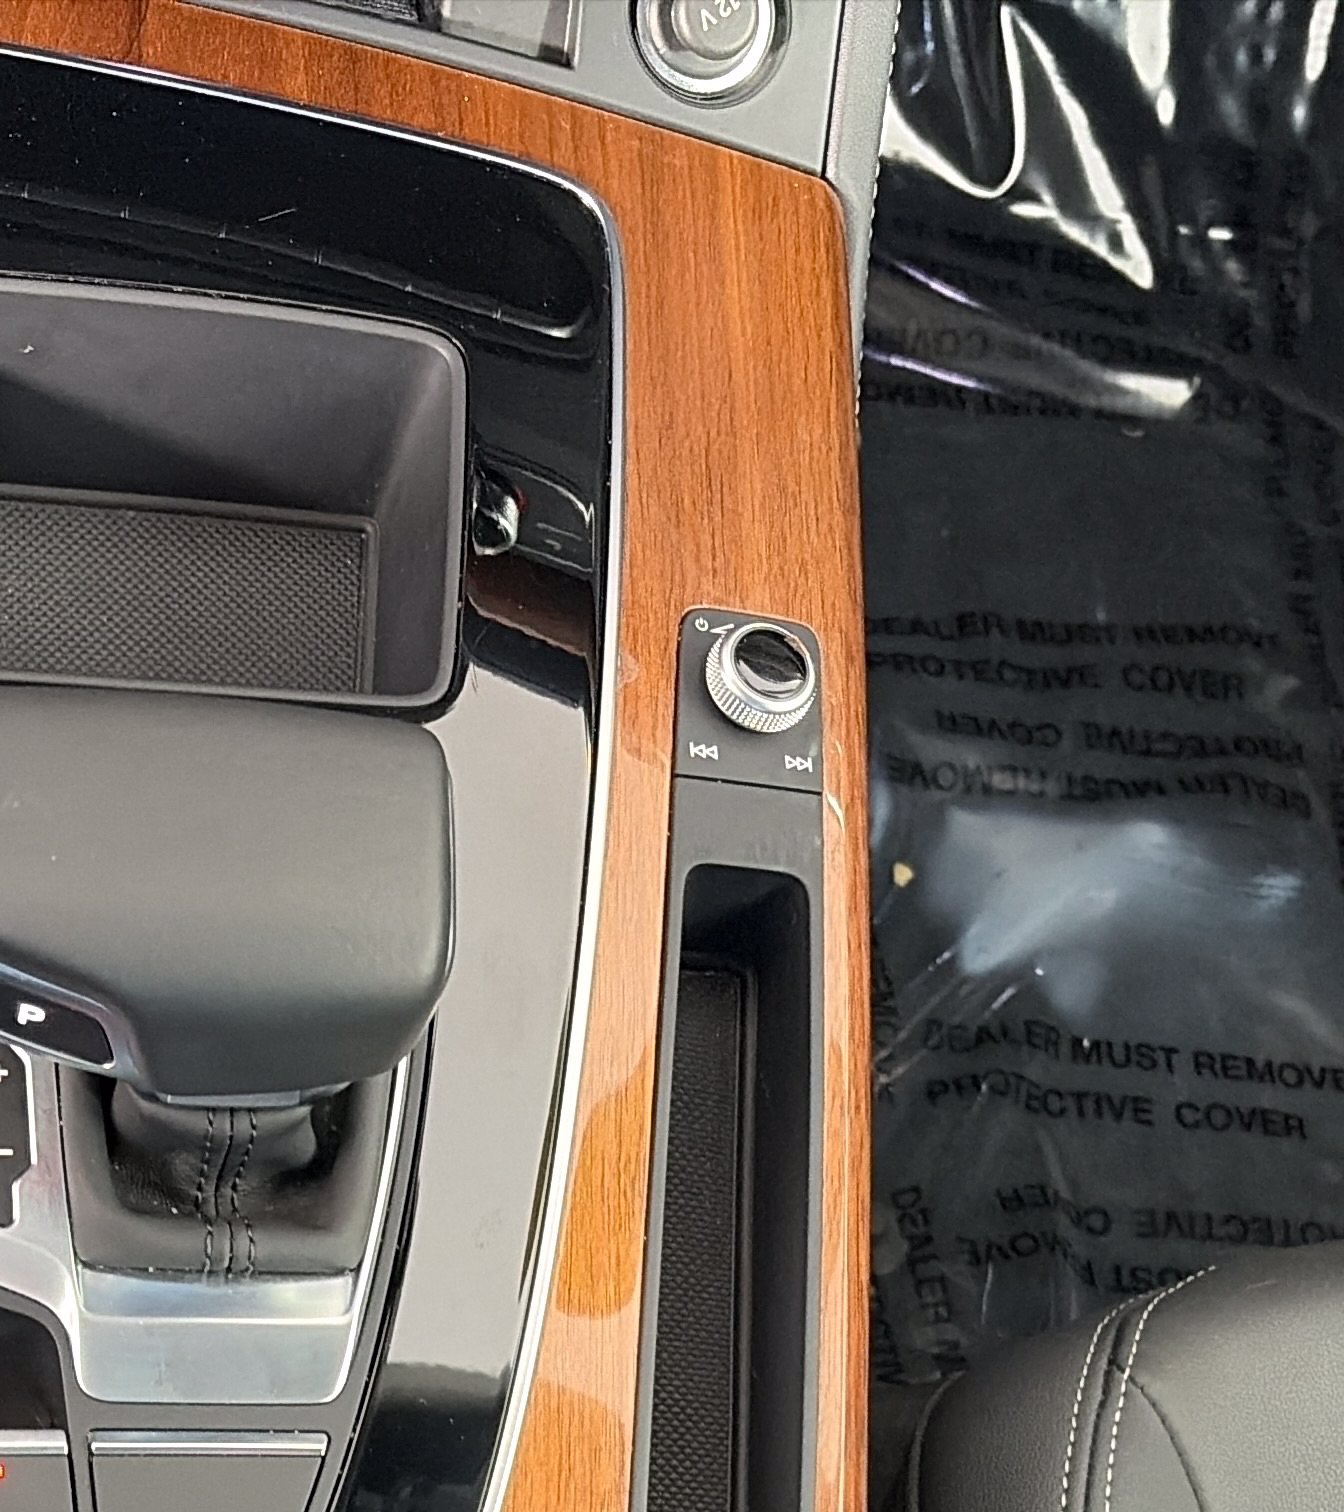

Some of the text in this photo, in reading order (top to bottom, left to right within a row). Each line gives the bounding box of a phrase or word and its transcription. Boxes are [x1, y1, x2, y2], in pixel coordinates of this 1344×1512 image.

[1120, 662, 1247, 701] COVER
[17, 1003, 46, 1025] P
[1068, 1031, 1182, 1076] MUST
[1172, 1100, 1309, 1142] COVER
